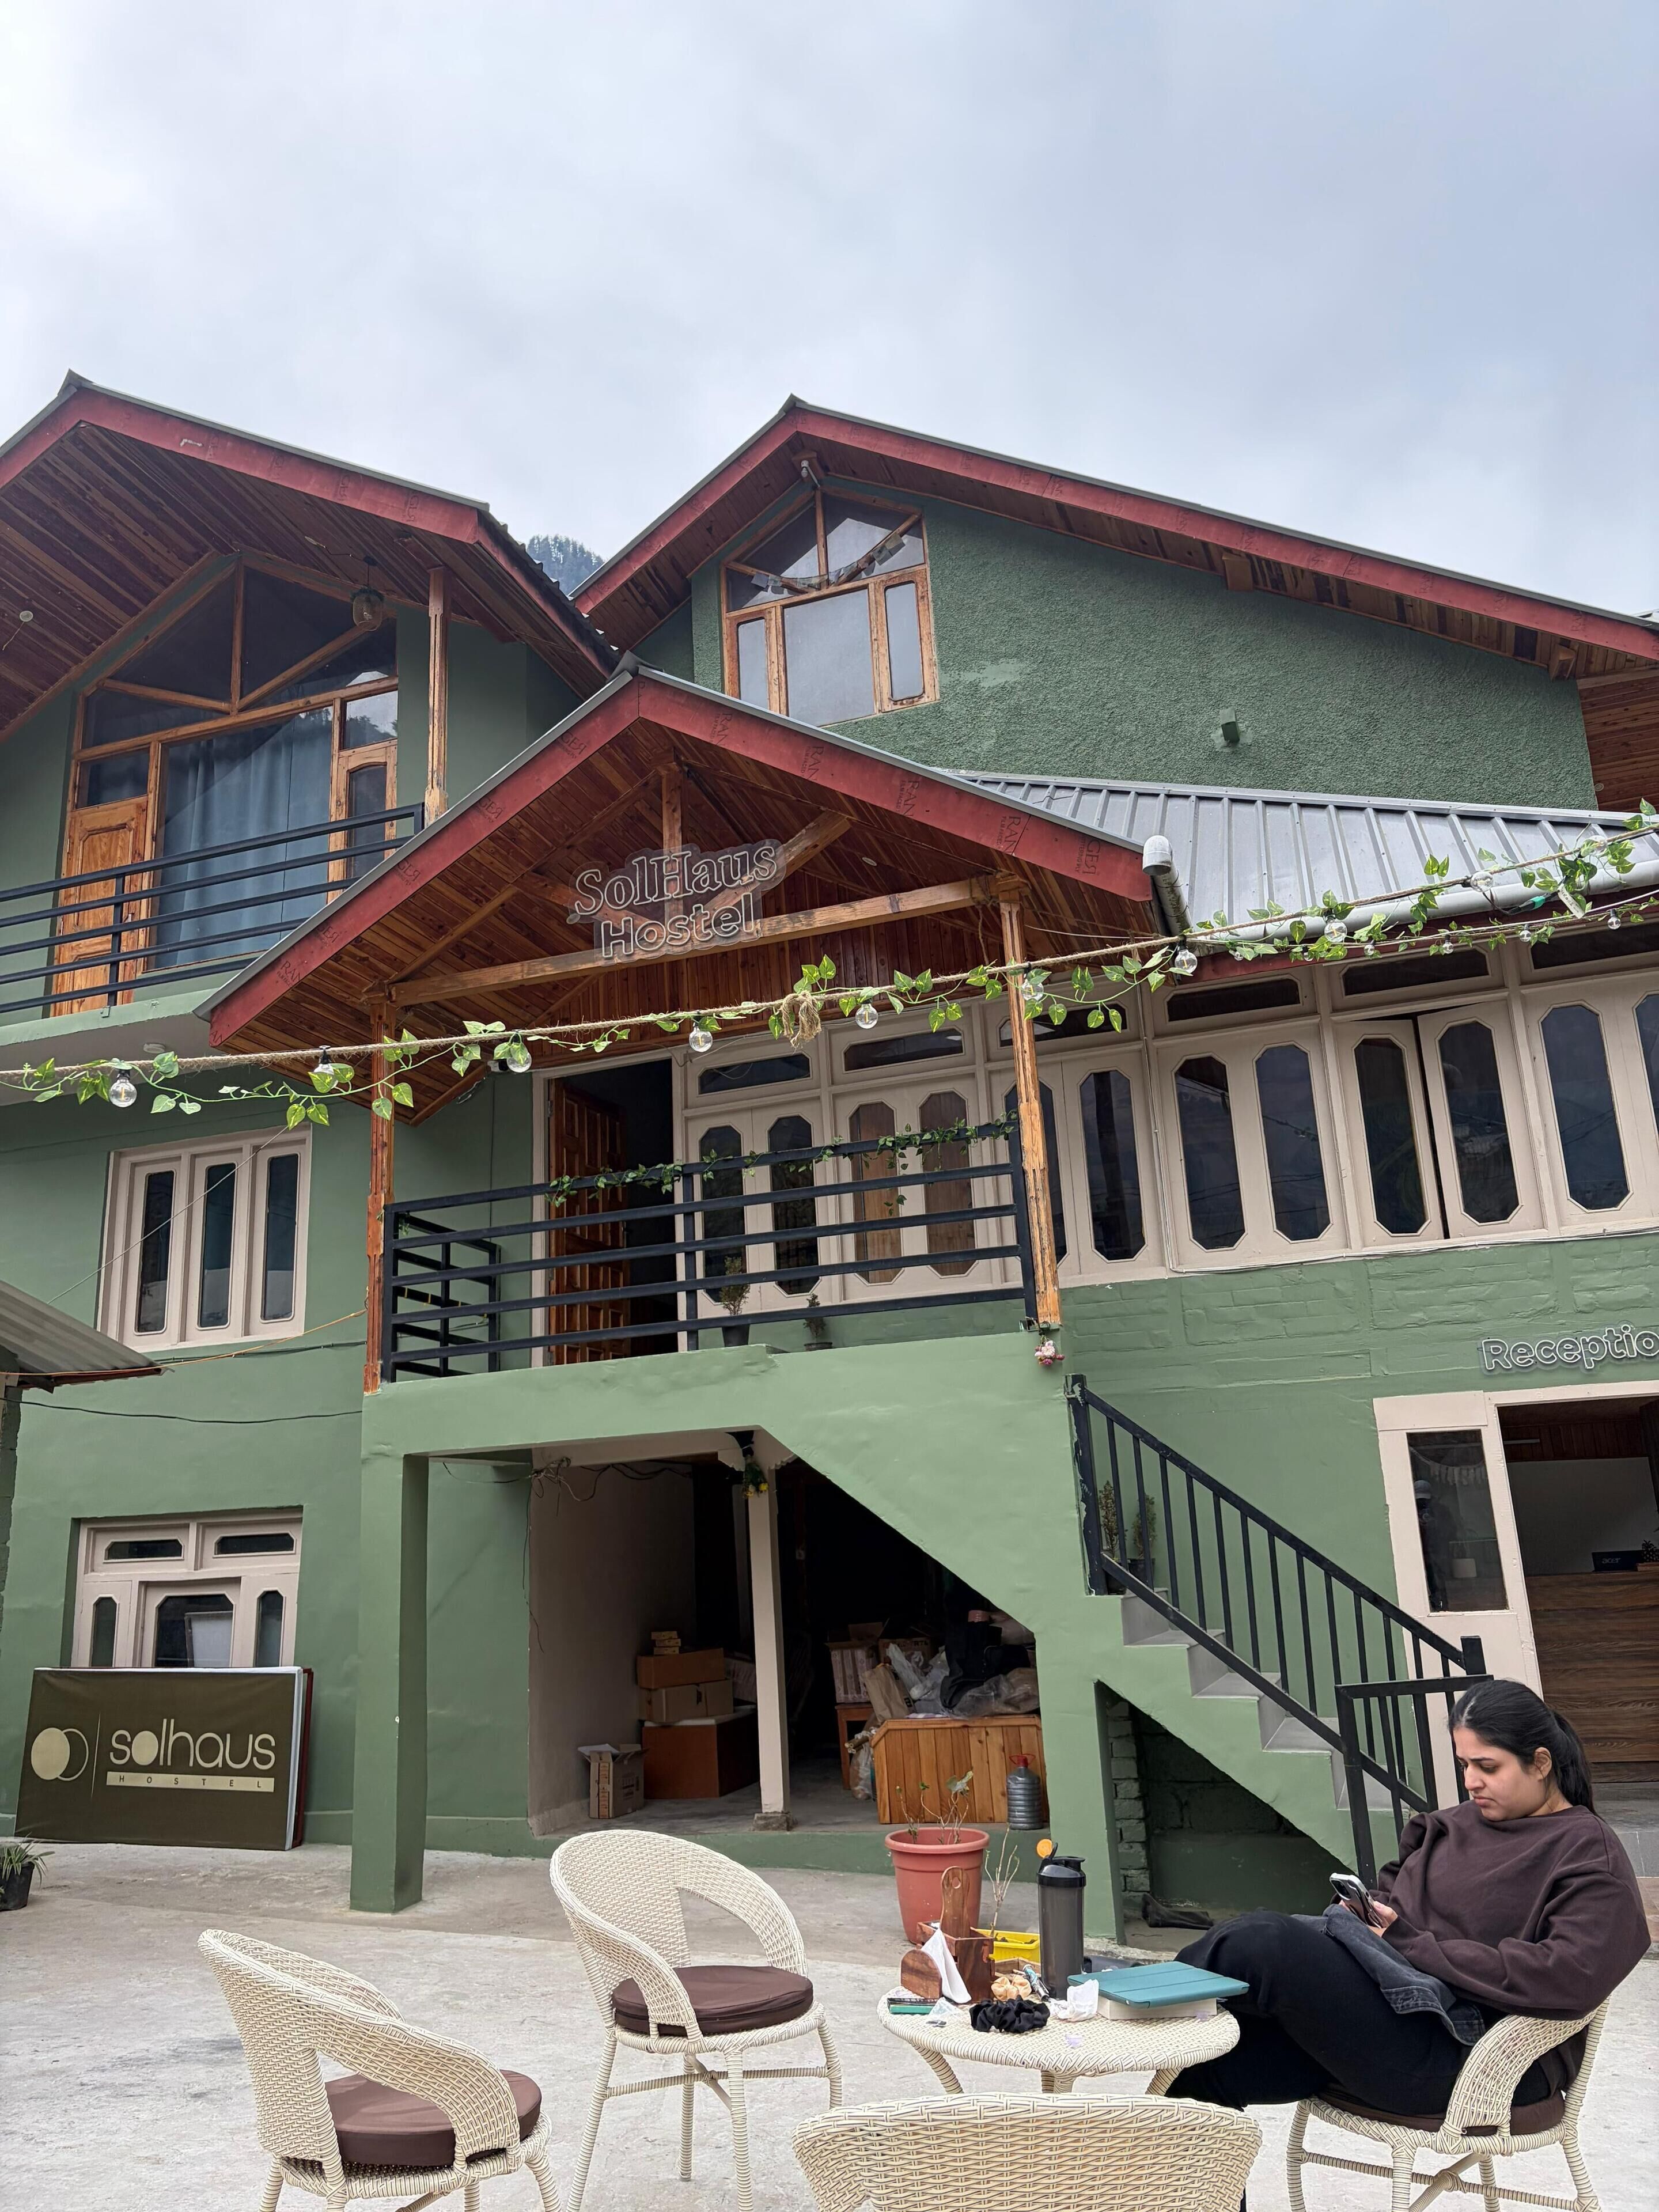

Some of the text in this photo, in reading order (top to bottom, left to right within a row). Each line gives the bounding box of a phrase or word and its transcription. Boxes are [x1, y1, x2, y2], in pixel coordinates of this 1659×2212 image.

[575, 846, 778, 915] SolHaus
[601, 892, 755, 958] Hostel
[109, 1718, 276, 1770] solhaus
[119, 1775, 262, 1789] HOSTEL
